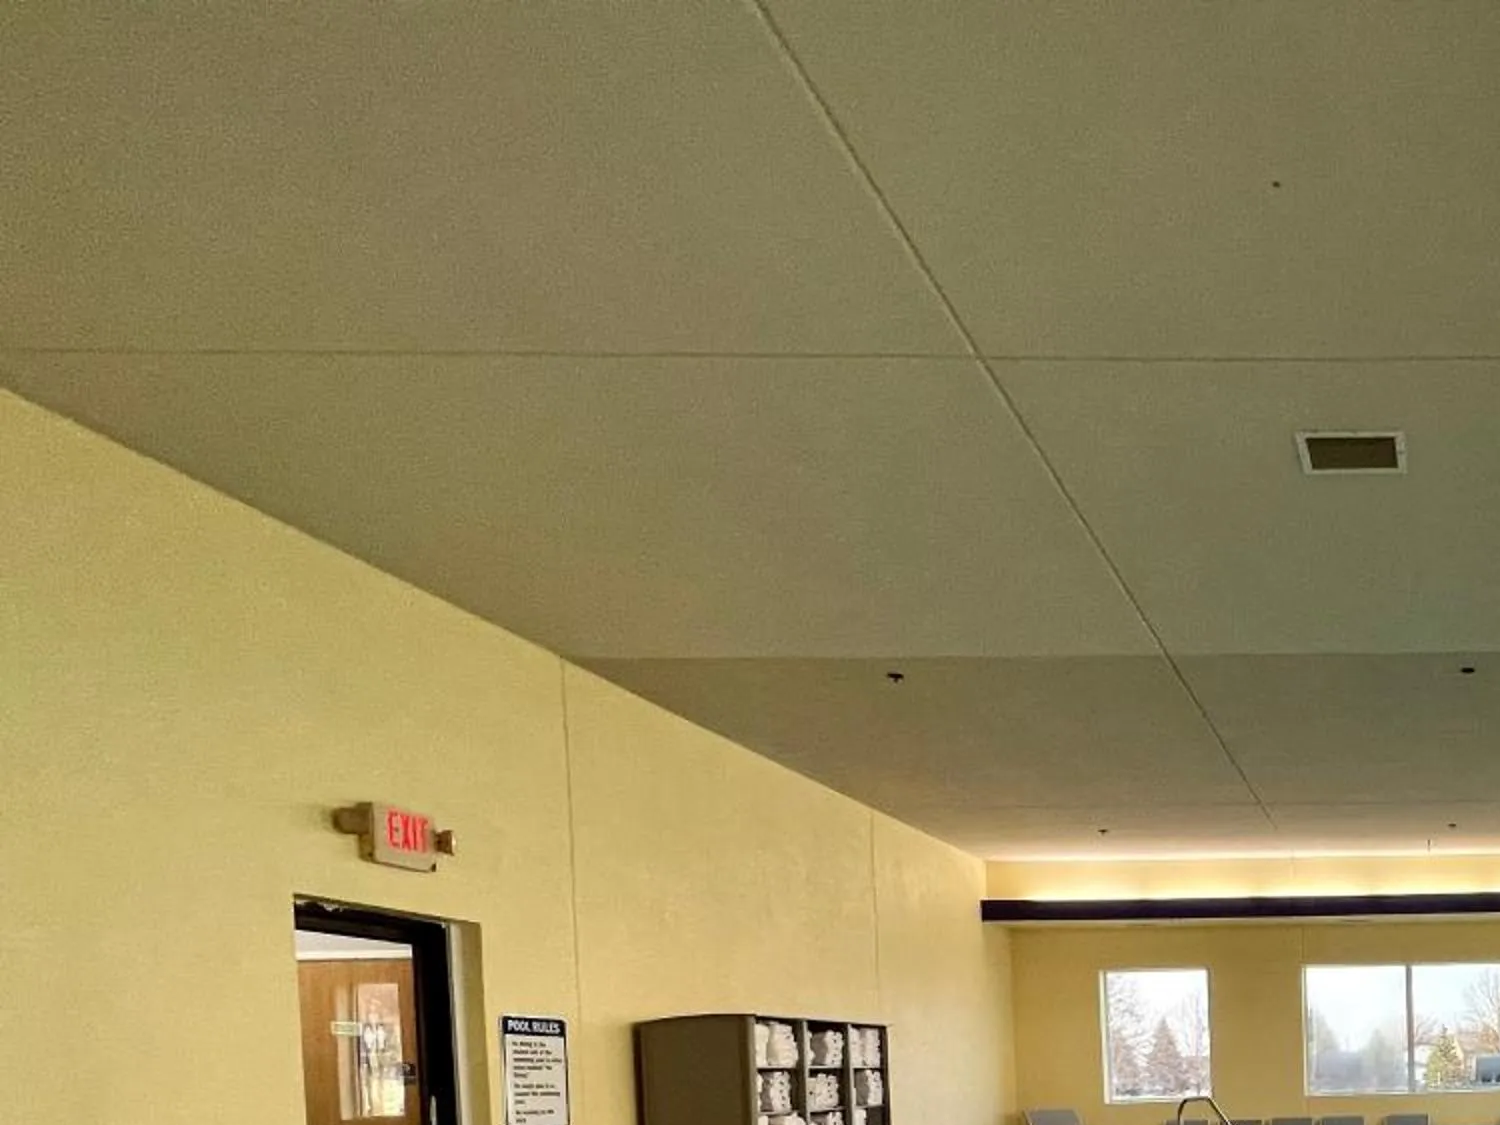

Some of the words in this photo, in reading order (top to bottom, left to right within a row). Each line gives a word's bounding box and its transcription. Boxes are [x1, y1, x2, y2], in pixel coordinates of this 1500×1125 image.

[386, 808, 429, 852] EXIT
[507, 1019, 531, 1033] POOL
[532, 1021, 561, 1035] RULES
